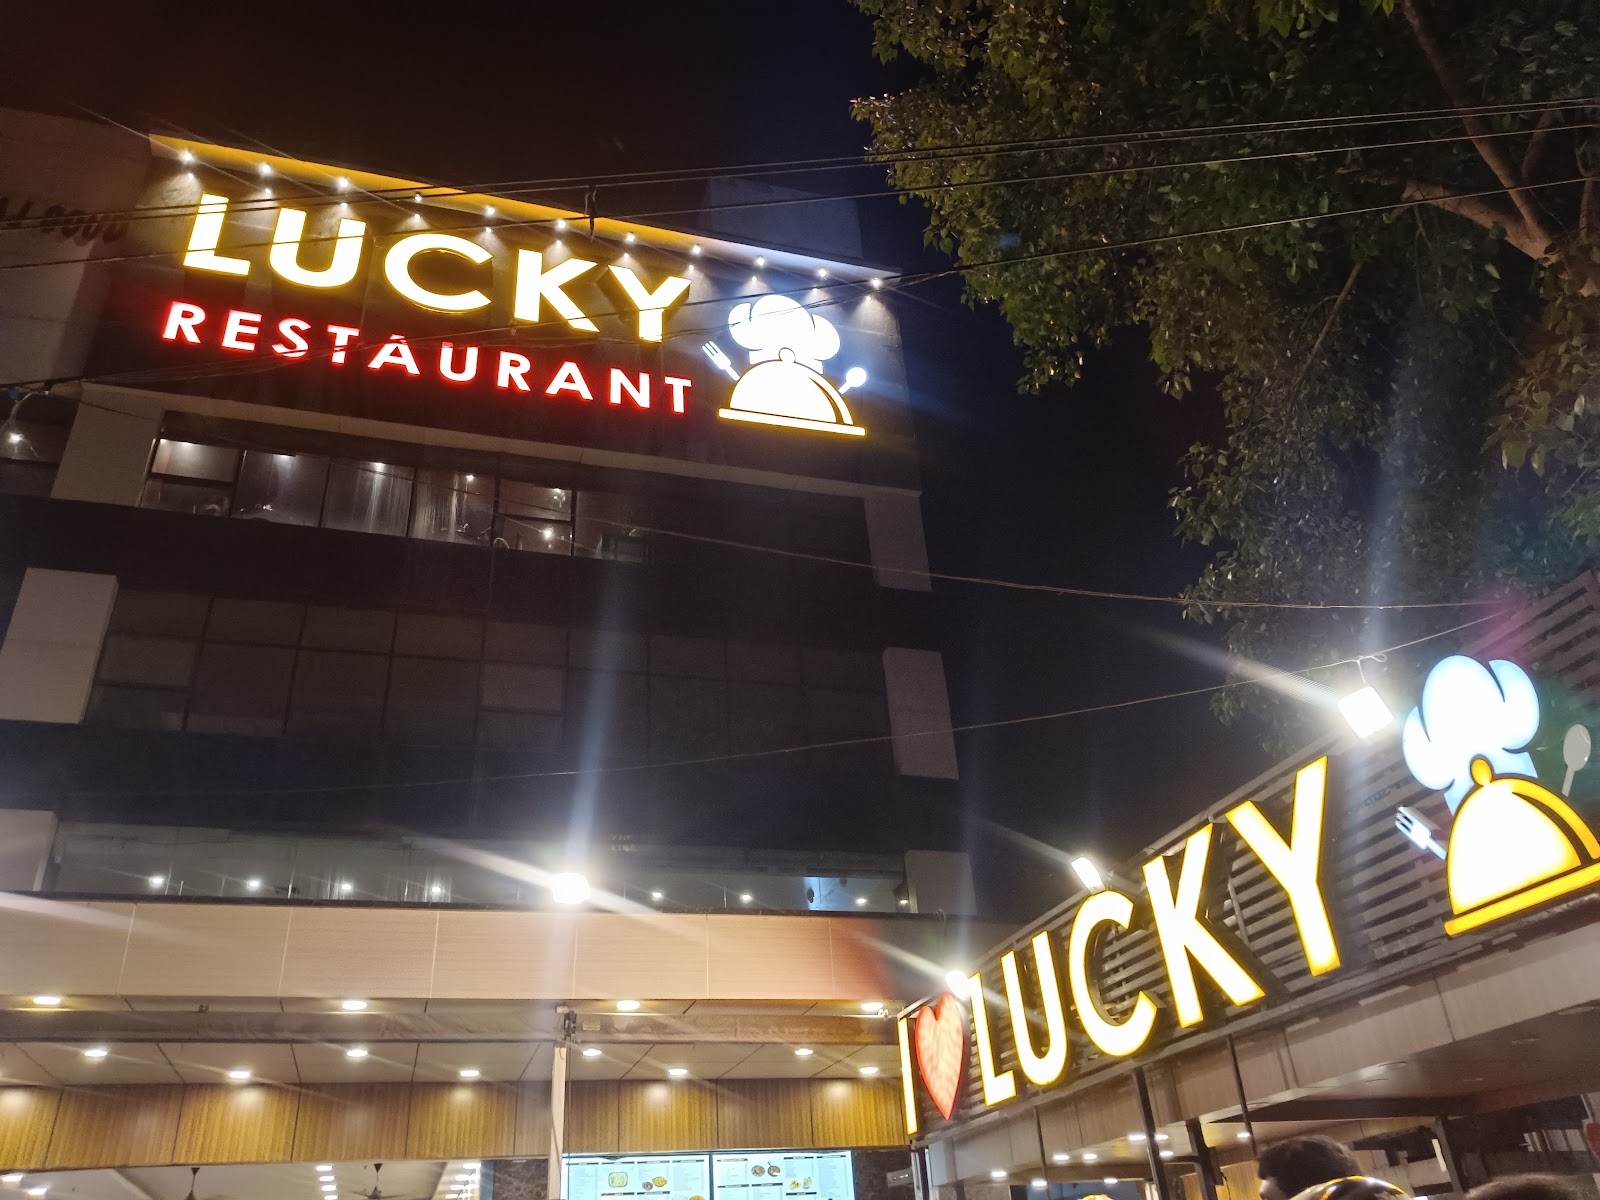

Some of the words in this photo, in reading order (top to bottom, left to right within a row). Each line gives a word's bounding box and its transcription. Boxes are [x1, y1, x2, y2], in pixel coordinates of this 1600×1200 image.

[182, 193, 693, 344] LUCKY
[162, 301, 693, 415] RESTAURANT
[898, 1017, 918, 1135] I
[969, 755, 1341, 1107] LUCKY
